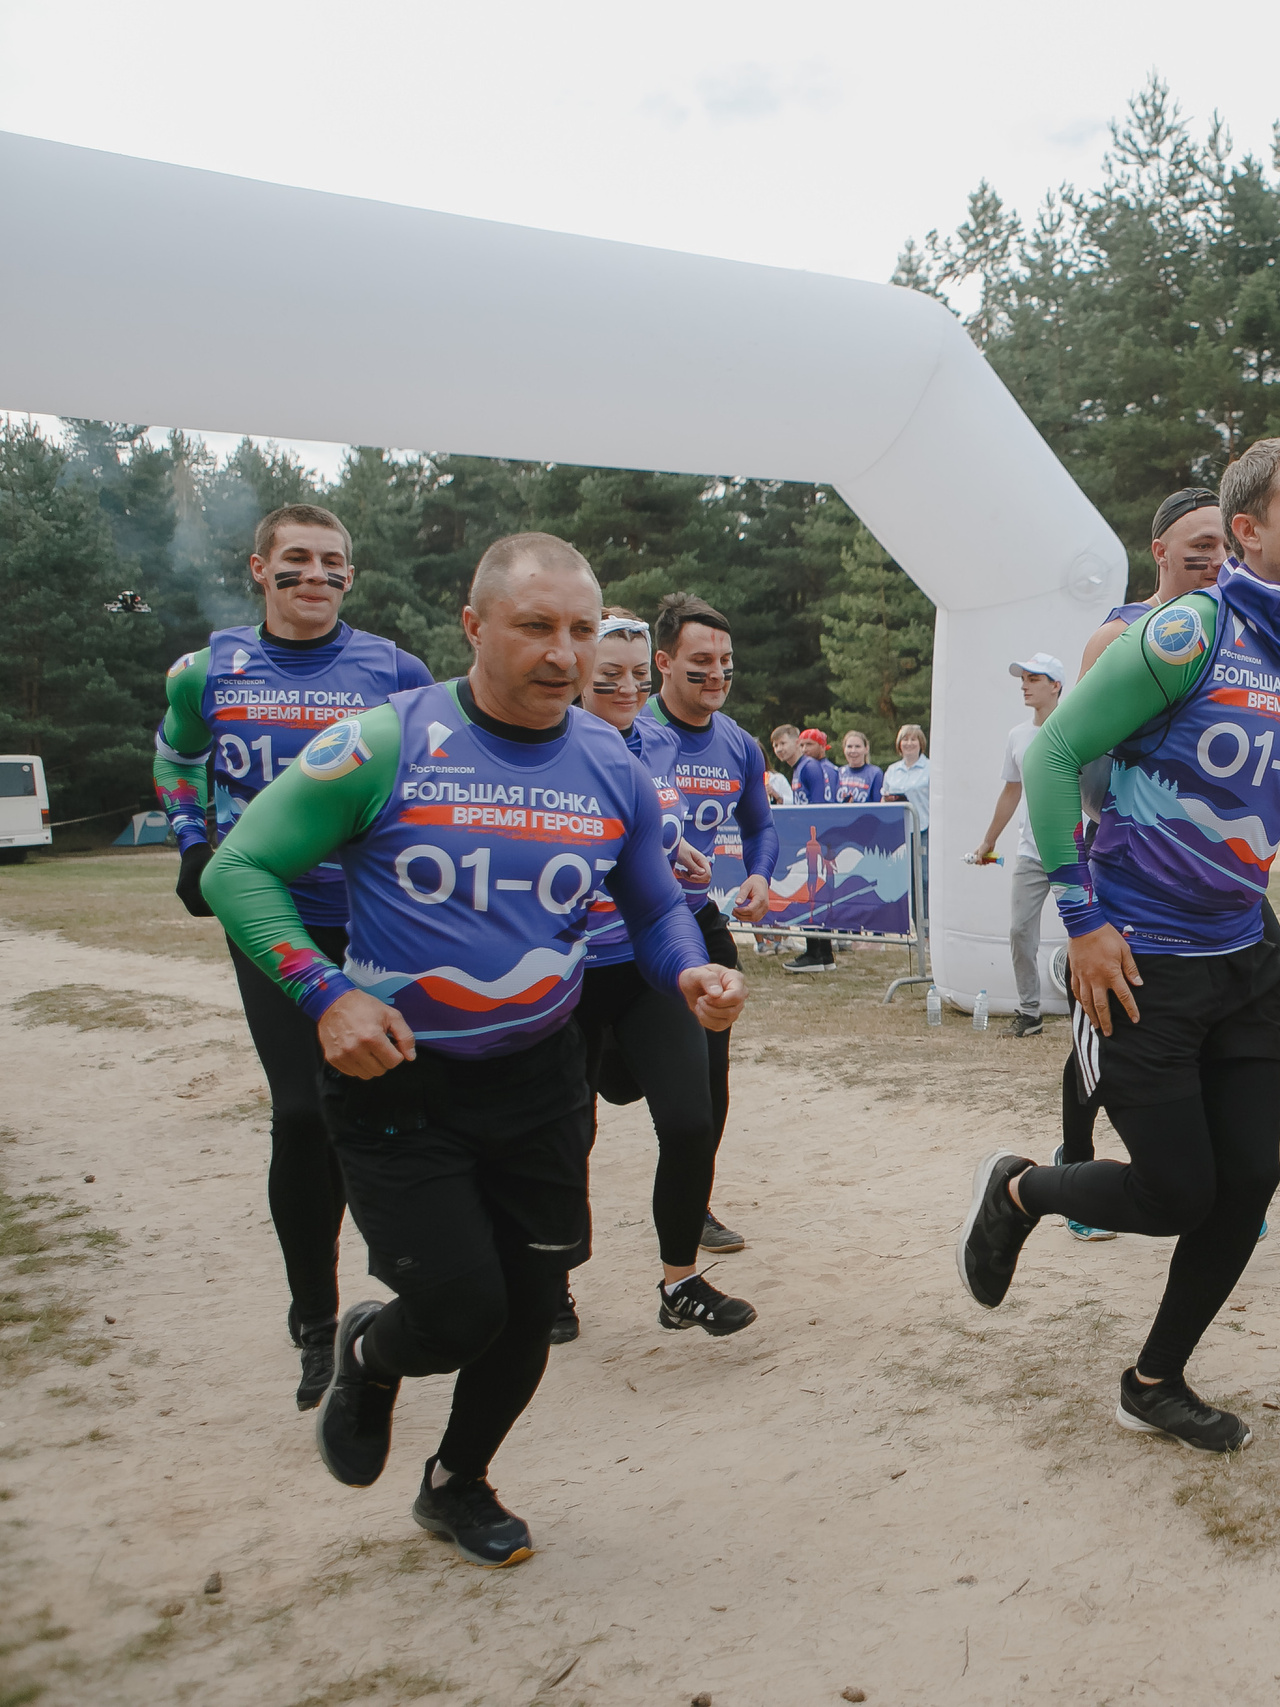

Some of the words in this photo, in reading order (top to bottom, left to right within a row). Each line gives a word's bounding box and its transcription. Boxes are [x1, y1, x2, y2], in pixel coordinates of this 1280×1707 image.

[1220, 649, 1263, 665] Ростелеком
[214, 690, 300, 705] БОЛЬШАЯ
[304, 690, 365, 707] ГОНКА
[247, 706, 301, 720] ВРЕМЯ
[304, 707, 367, 721] ГЕРОЕ
[409, 763, 475, 775] Ростелеком
[692, 765, 730, 780] ГОНКА
[693, 778, 732, 792] ГЕРОЕВ
[402, 780, 524, 806] БОЛЬШАЯ
[530, 787, 602, 816] ГОНКА
[453, 807, 527, 828] ВРЕМЯ
[531, 811, 605, 837] ГЕРОЕВ
